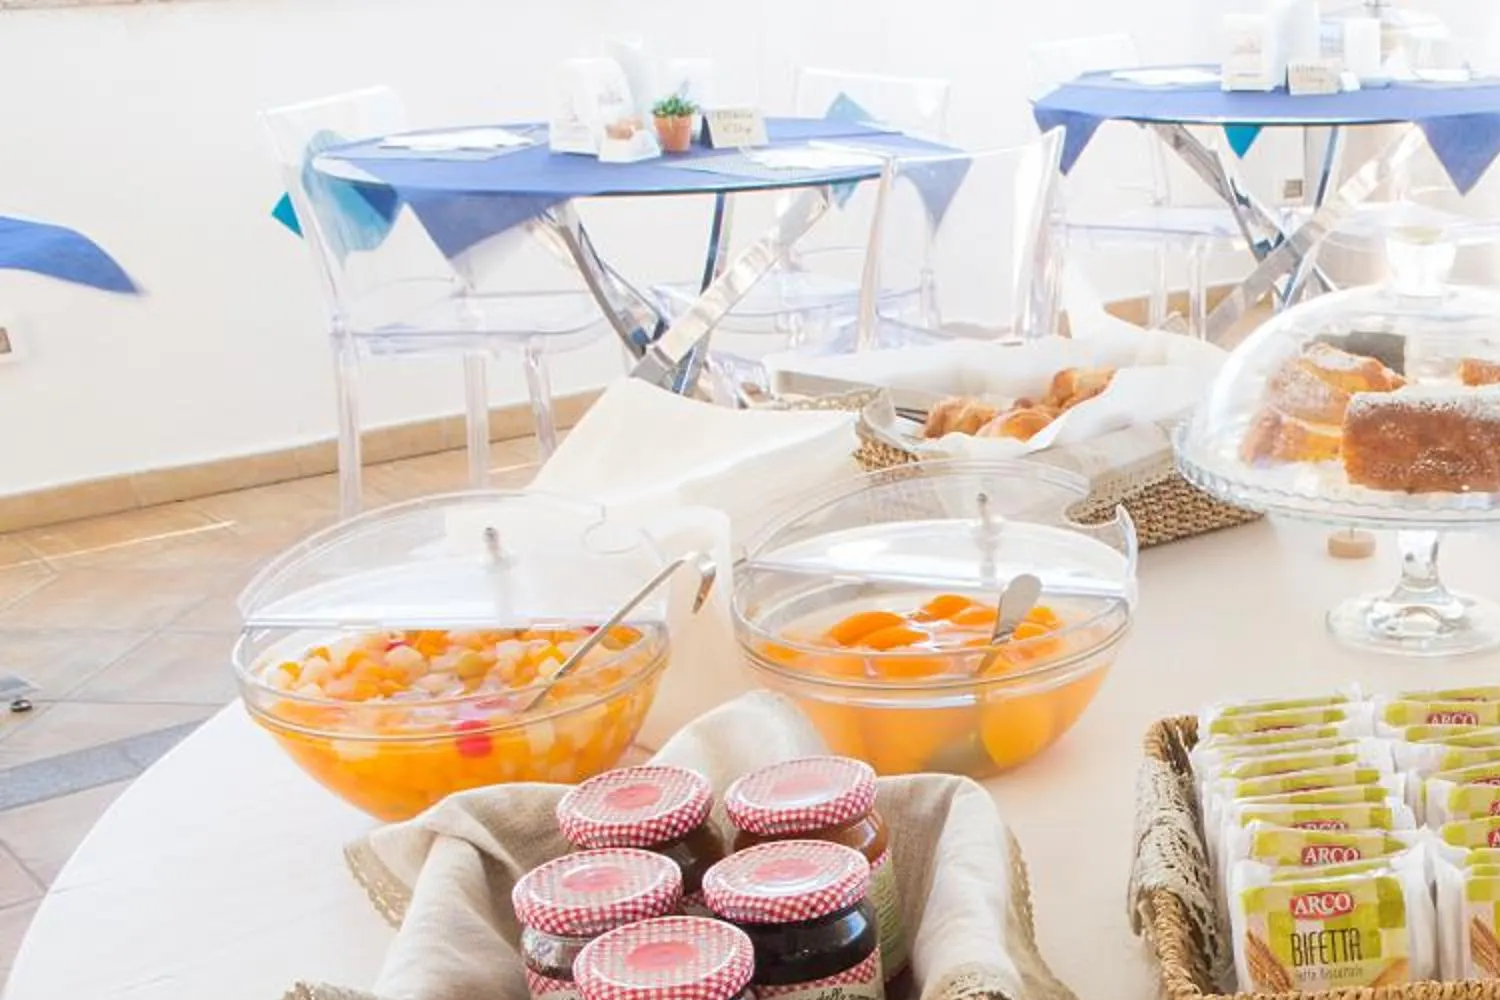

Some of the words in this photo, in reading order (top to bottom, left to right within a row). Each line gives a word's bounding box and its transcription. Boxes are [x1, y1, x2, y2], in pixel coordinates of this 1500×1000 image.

[1303, 847, 1359, 864] ARCO
[1294, 893, 1352, 915] ARCO
[1290, 927, 1363, 967] BIFETTA
